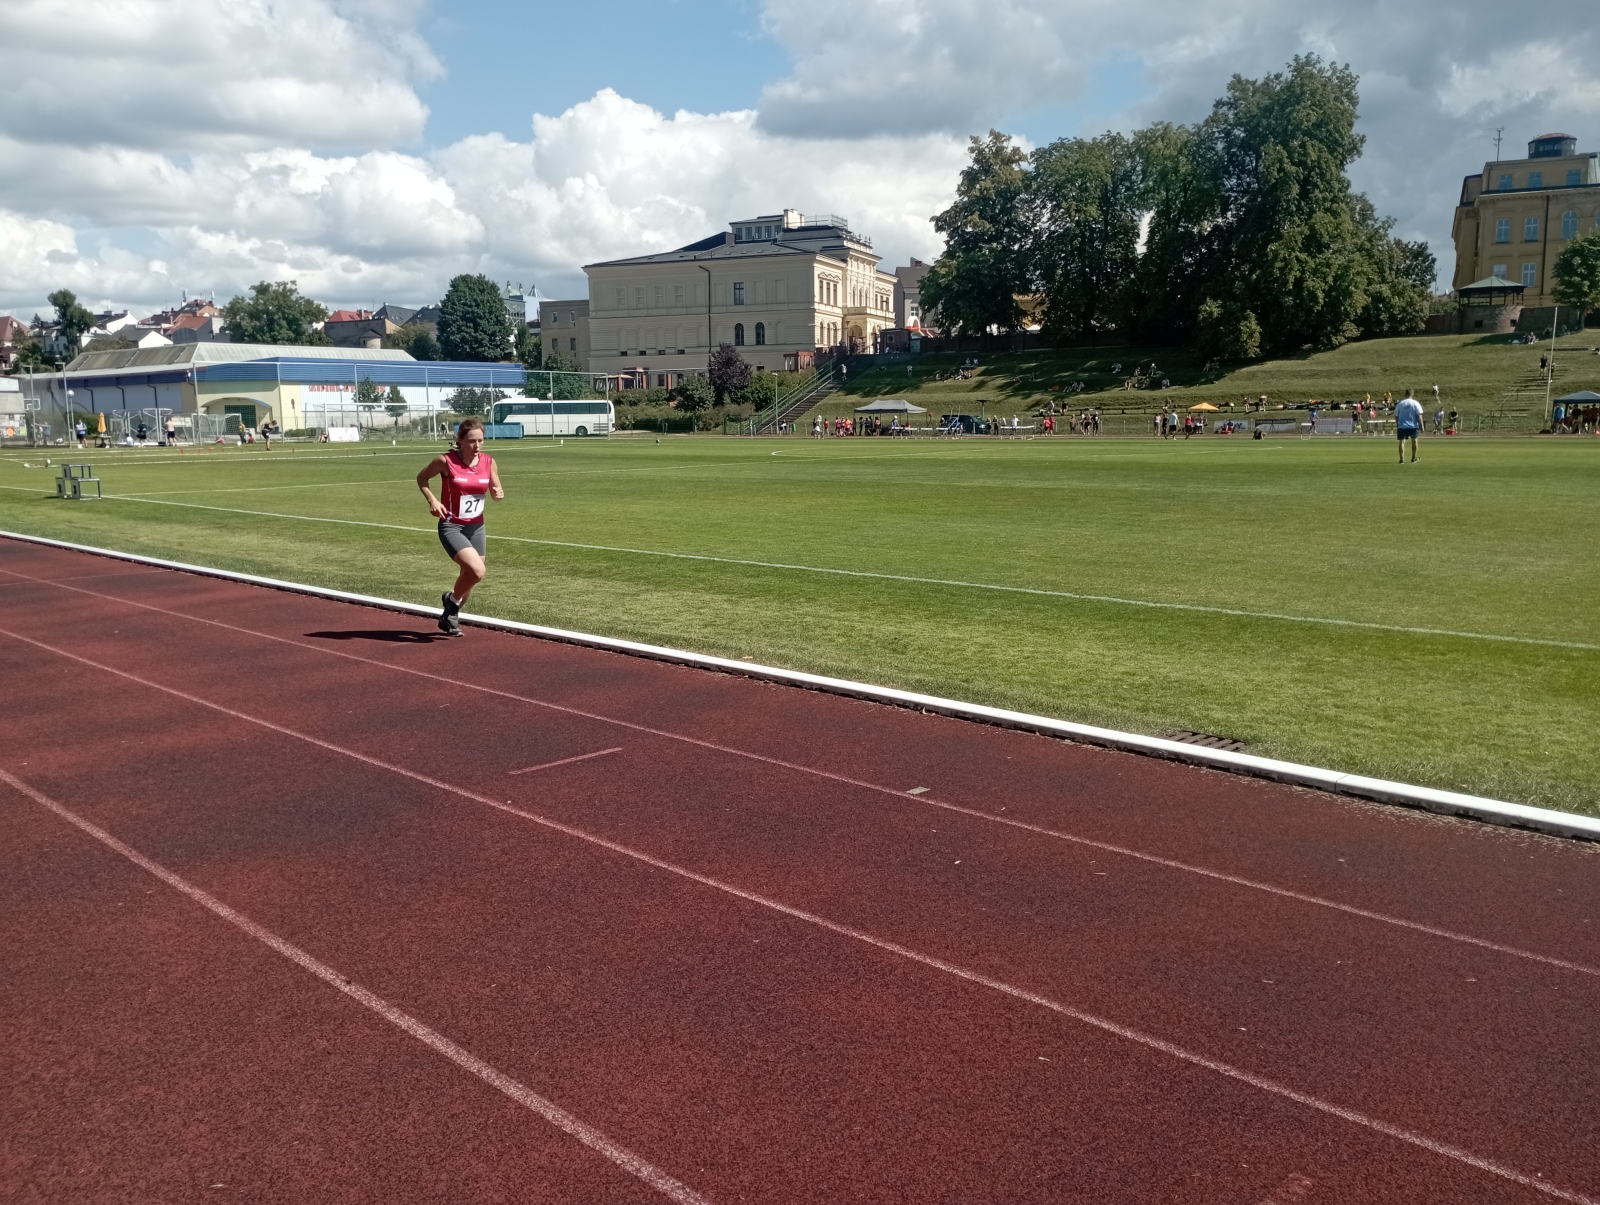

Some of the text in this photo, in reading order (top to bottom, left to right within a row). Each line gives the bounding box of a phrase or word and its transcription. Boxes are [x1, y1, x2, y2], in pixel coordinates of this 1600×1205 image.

[64, 468, 67, 478] 1
[58, 484, 62, 493] 2
[464, 499, 480, 513] 27
